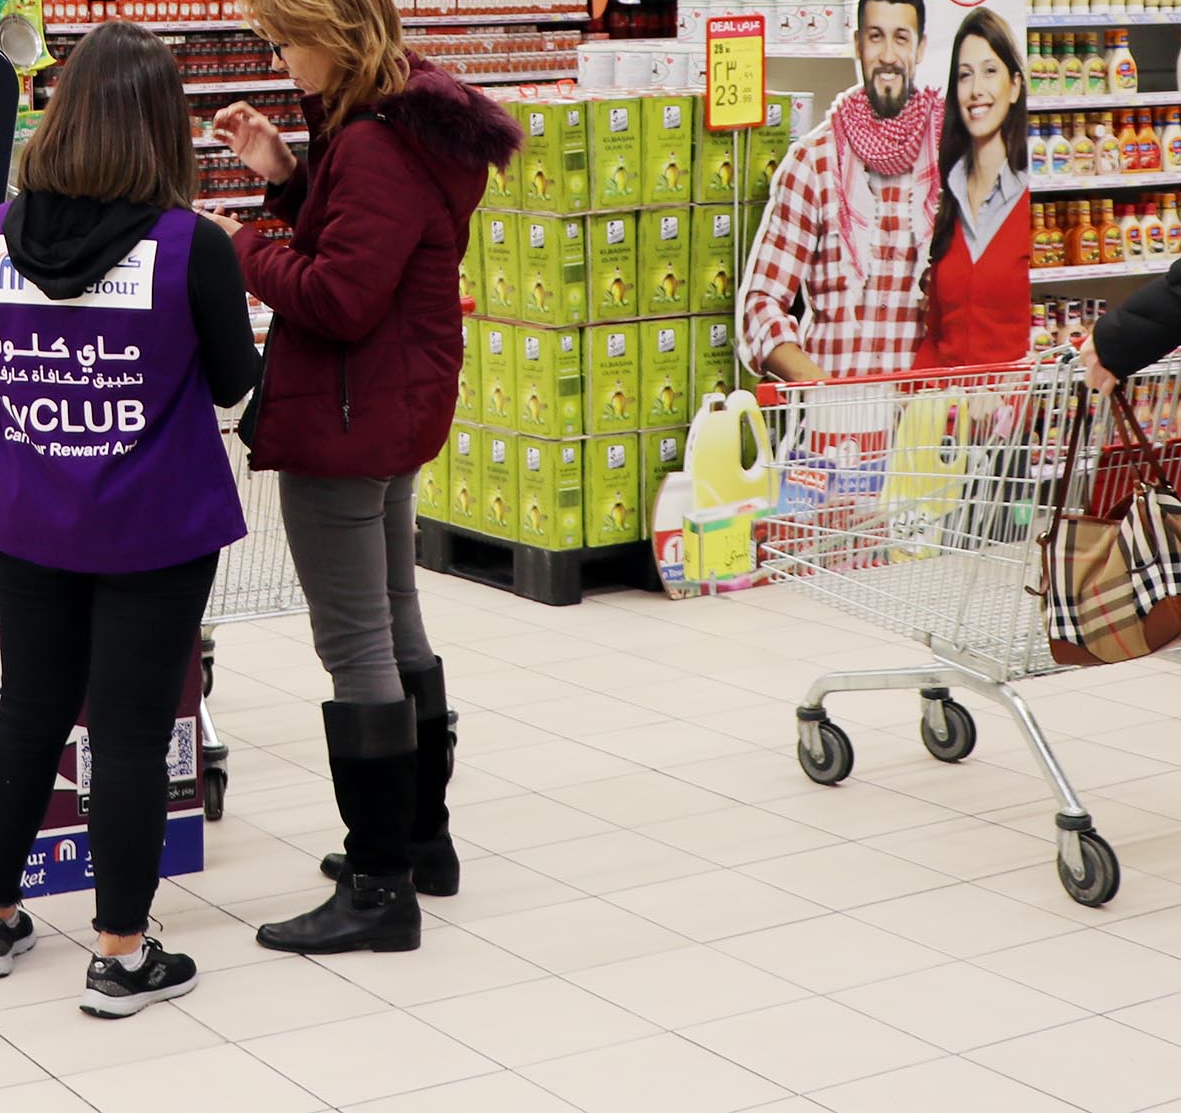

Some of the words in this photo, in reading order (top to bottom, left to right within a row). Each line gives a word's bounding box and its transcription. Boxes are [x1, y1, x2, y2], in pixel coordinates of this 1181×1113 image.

[710, 21, 736, 32] DEAL
[738, 20, 760, 31] عرض
[76, 335, 140, 373] ماي
[31, 365, 90, 385] مكافأة
[92, 373, 144, 389] تطبيق
[50, 442, 109, 456] Reward
